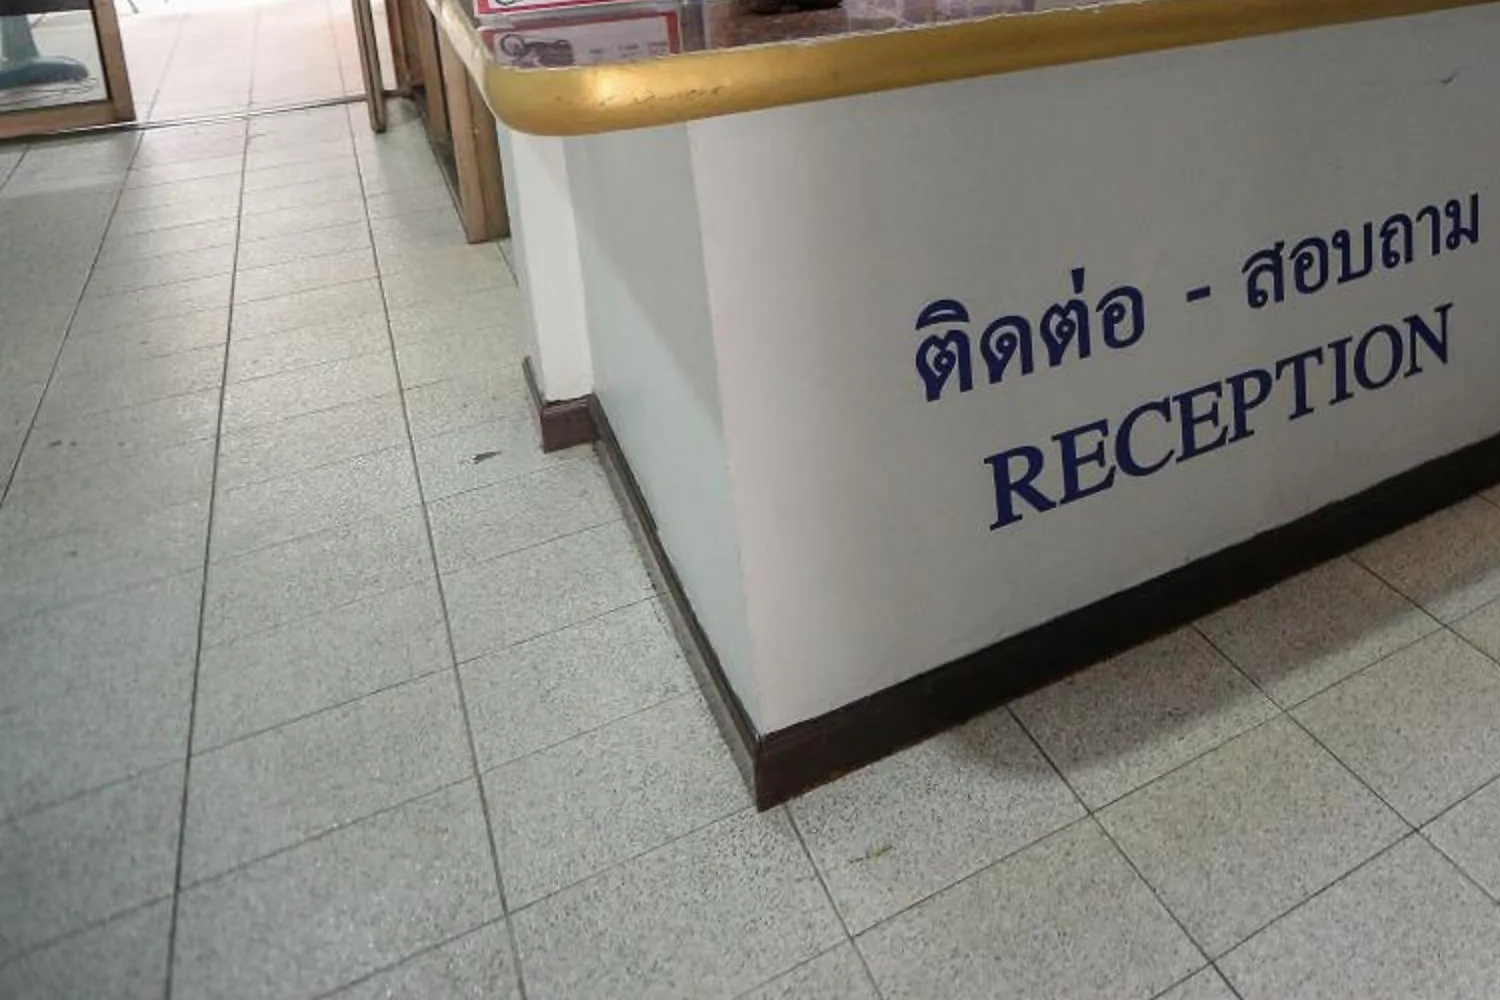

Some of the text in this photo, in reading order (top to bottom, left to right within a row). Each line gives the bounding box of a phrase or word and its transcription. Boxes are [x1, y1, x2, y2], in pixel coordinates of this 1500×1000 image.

[914, 267, 1146, 402] ติดต่อ
[1242, 193, 1480, 309] สอบถาม
[983, 303, 1453, 531] RECEPTION
